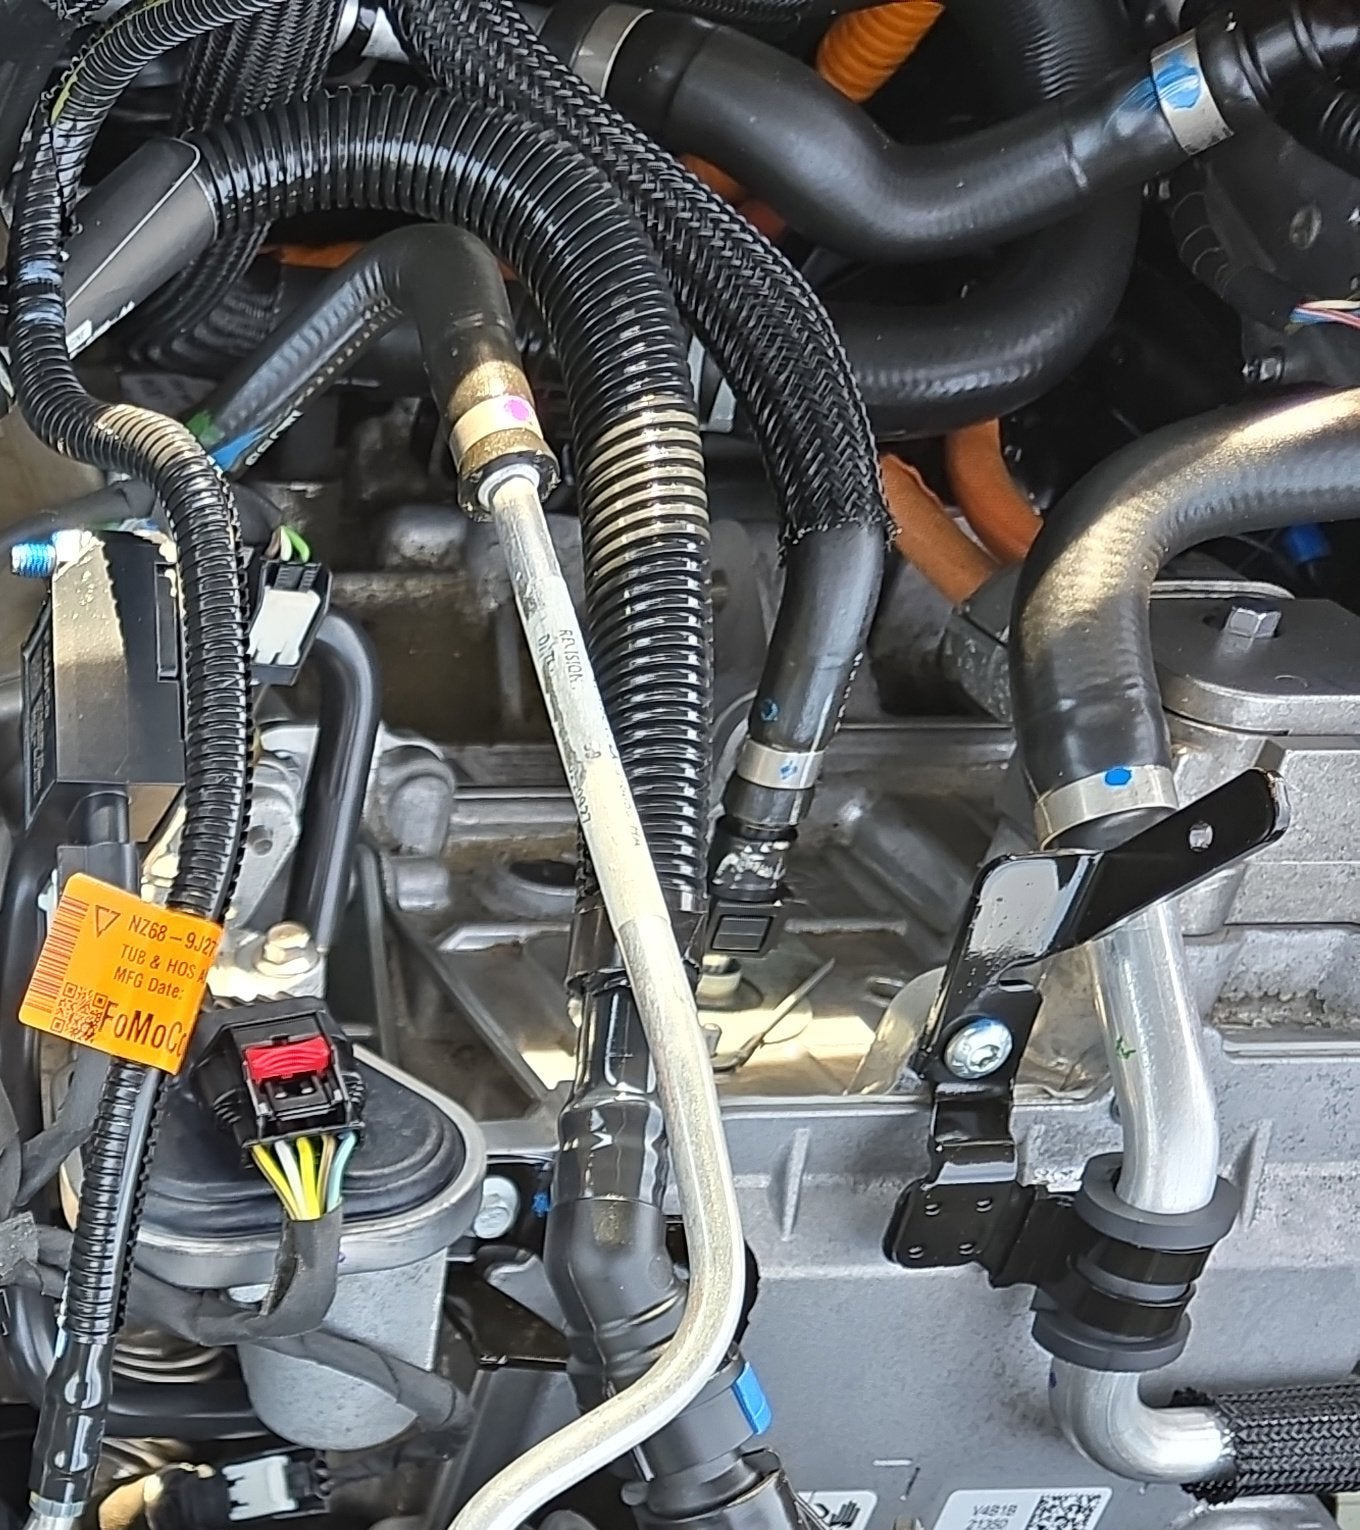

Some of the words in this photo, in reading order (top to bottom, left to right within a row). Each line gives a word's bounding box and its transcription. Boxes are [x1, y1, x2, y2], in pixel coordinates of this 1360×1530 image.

[120, 944, 147, 966] TUB
[149, 955, 162, 969] &
[166, 958, 197, 980] HOS
[113, 966, 144, 988] MFG
[148, 978, 185, 1000] Date:
